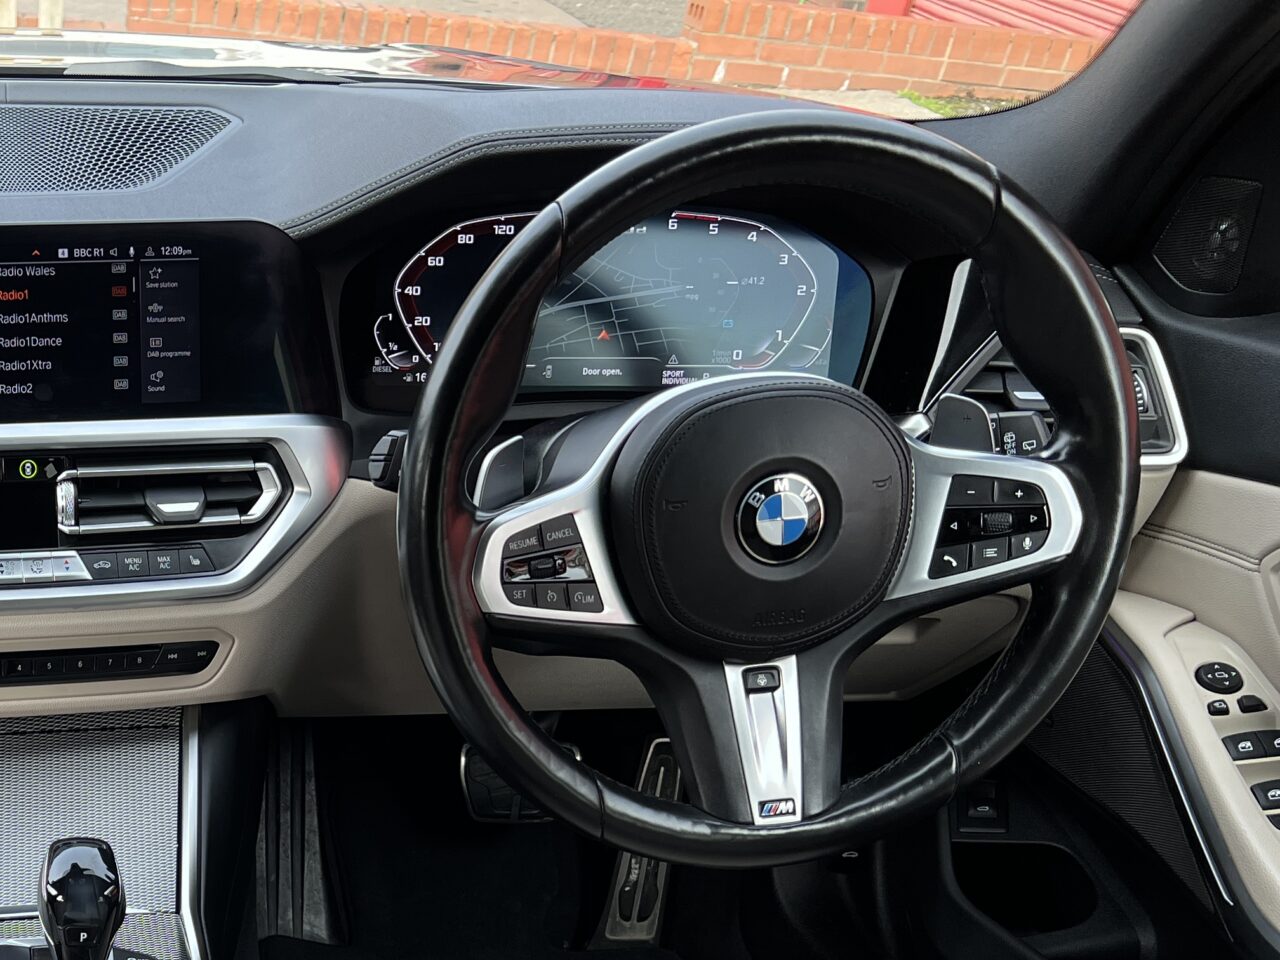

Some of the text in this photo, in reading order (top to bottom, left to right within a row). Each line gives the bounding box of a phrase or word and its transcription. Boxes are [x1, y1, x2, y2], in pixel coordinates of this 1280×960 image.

[668, 219, 678, 230] 6
[709, 224, 719, 235] 5
[492, 225, 515, 235] 120
[457, 234, 474, 244] 80
[747, 231, 757, 242] 4
[73, 248, 92, 258] BBC
[93, 247, 104, 257] R1
[427, 256, 444, 267] 60
[779, 254, 789, 265] 3
[25, 265, 56, 276] Wales
[404, 286, 421, 296] 40
[796, 285, 806, 296] 2
[414, 316, 431, 326] 20
[775, 329, 783, 342] 1
[412, 355, 419, 363] 0
[732, 350, 743, 361] 0
[372, 365, 393, 373] DIESEL
[582, 367, 623, 377] Door open.
[662, 370, 685, 378] SPORT
[0, 383, 33, 394] Radio2
[747, 477, 816, 508] BMW
[546, 528, 574, 541] CANCEL
[508, 536, 539, 550] RESUME
[124, 556, 142, 566] MENU
[157, 555, 171, 563] MAX
[128, 563, 141, 572] A/C
[159, 561, 171, 569] A/C
[513, 589, 527, 599] SET
[582, 594, 595, 603] LIM
[80, 933, 88, 943] P
